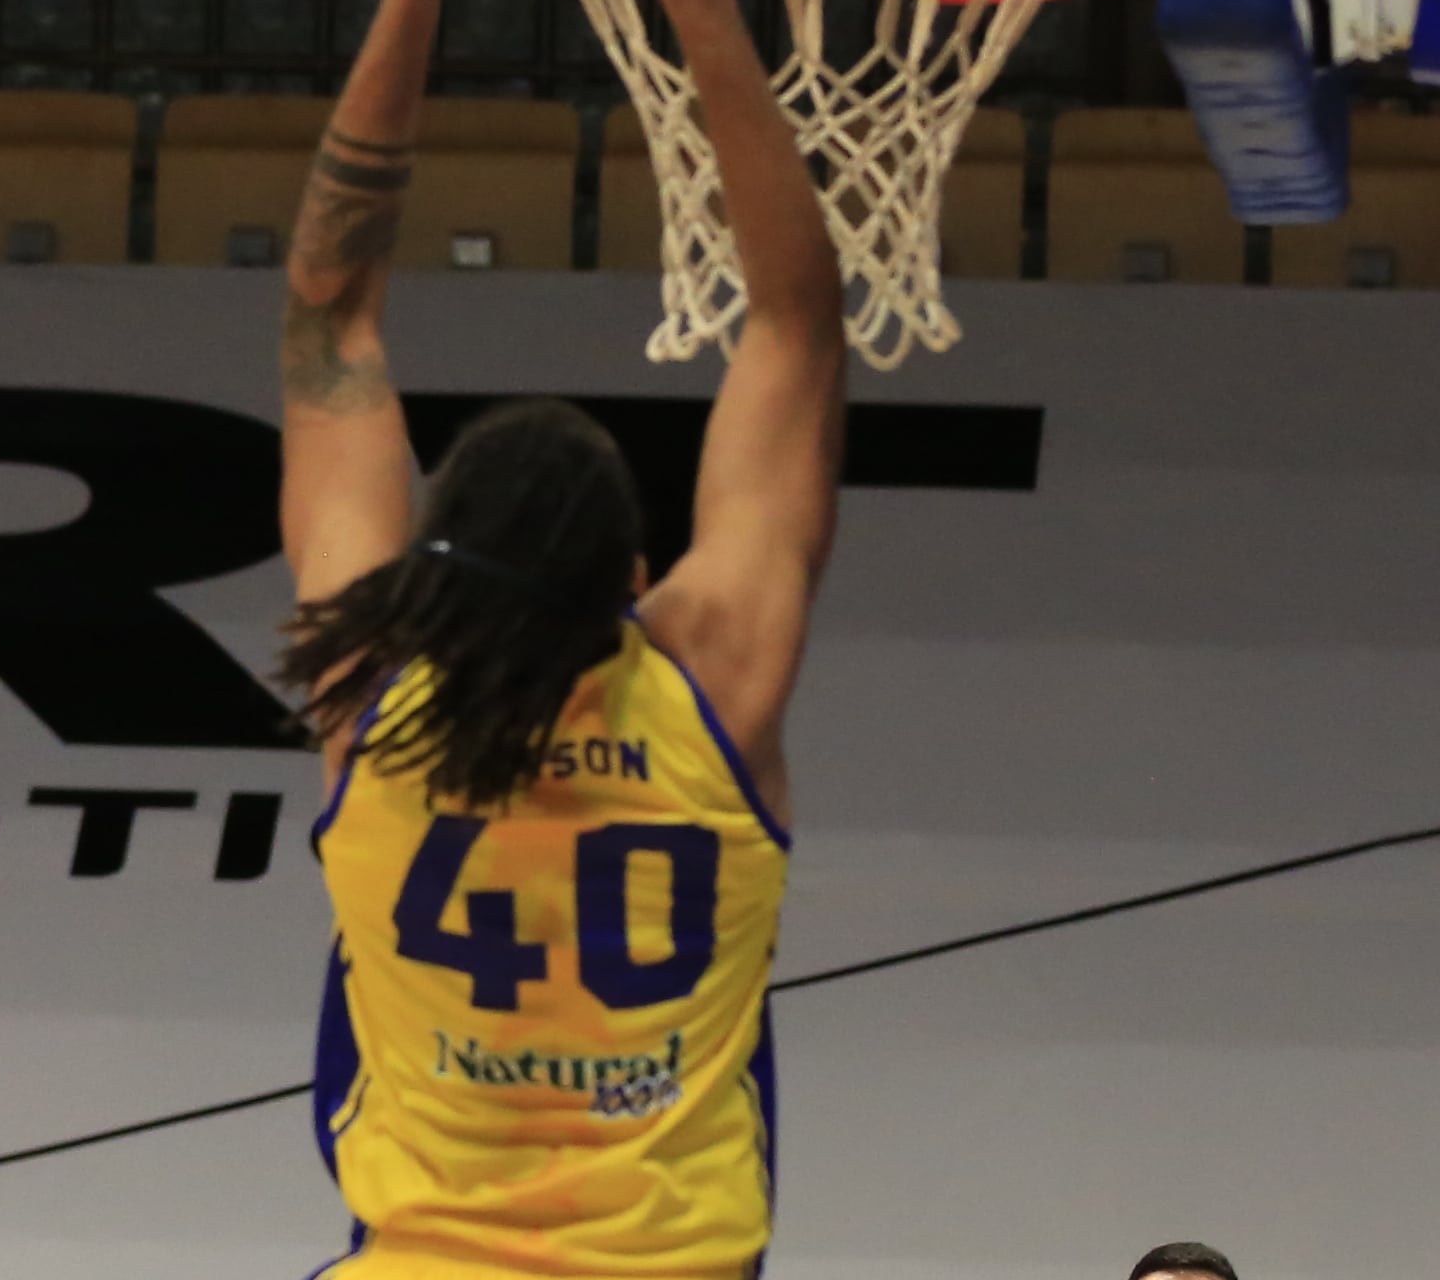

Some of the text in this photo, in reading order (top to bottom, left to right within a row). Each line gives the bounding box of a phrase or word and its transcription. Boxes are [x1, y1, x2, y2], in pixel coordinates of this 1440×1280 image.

[550, 737, 650, 782] SON
[392, 814, 720, 1012] 40
[433, 1028, 684, 1092] Natural
